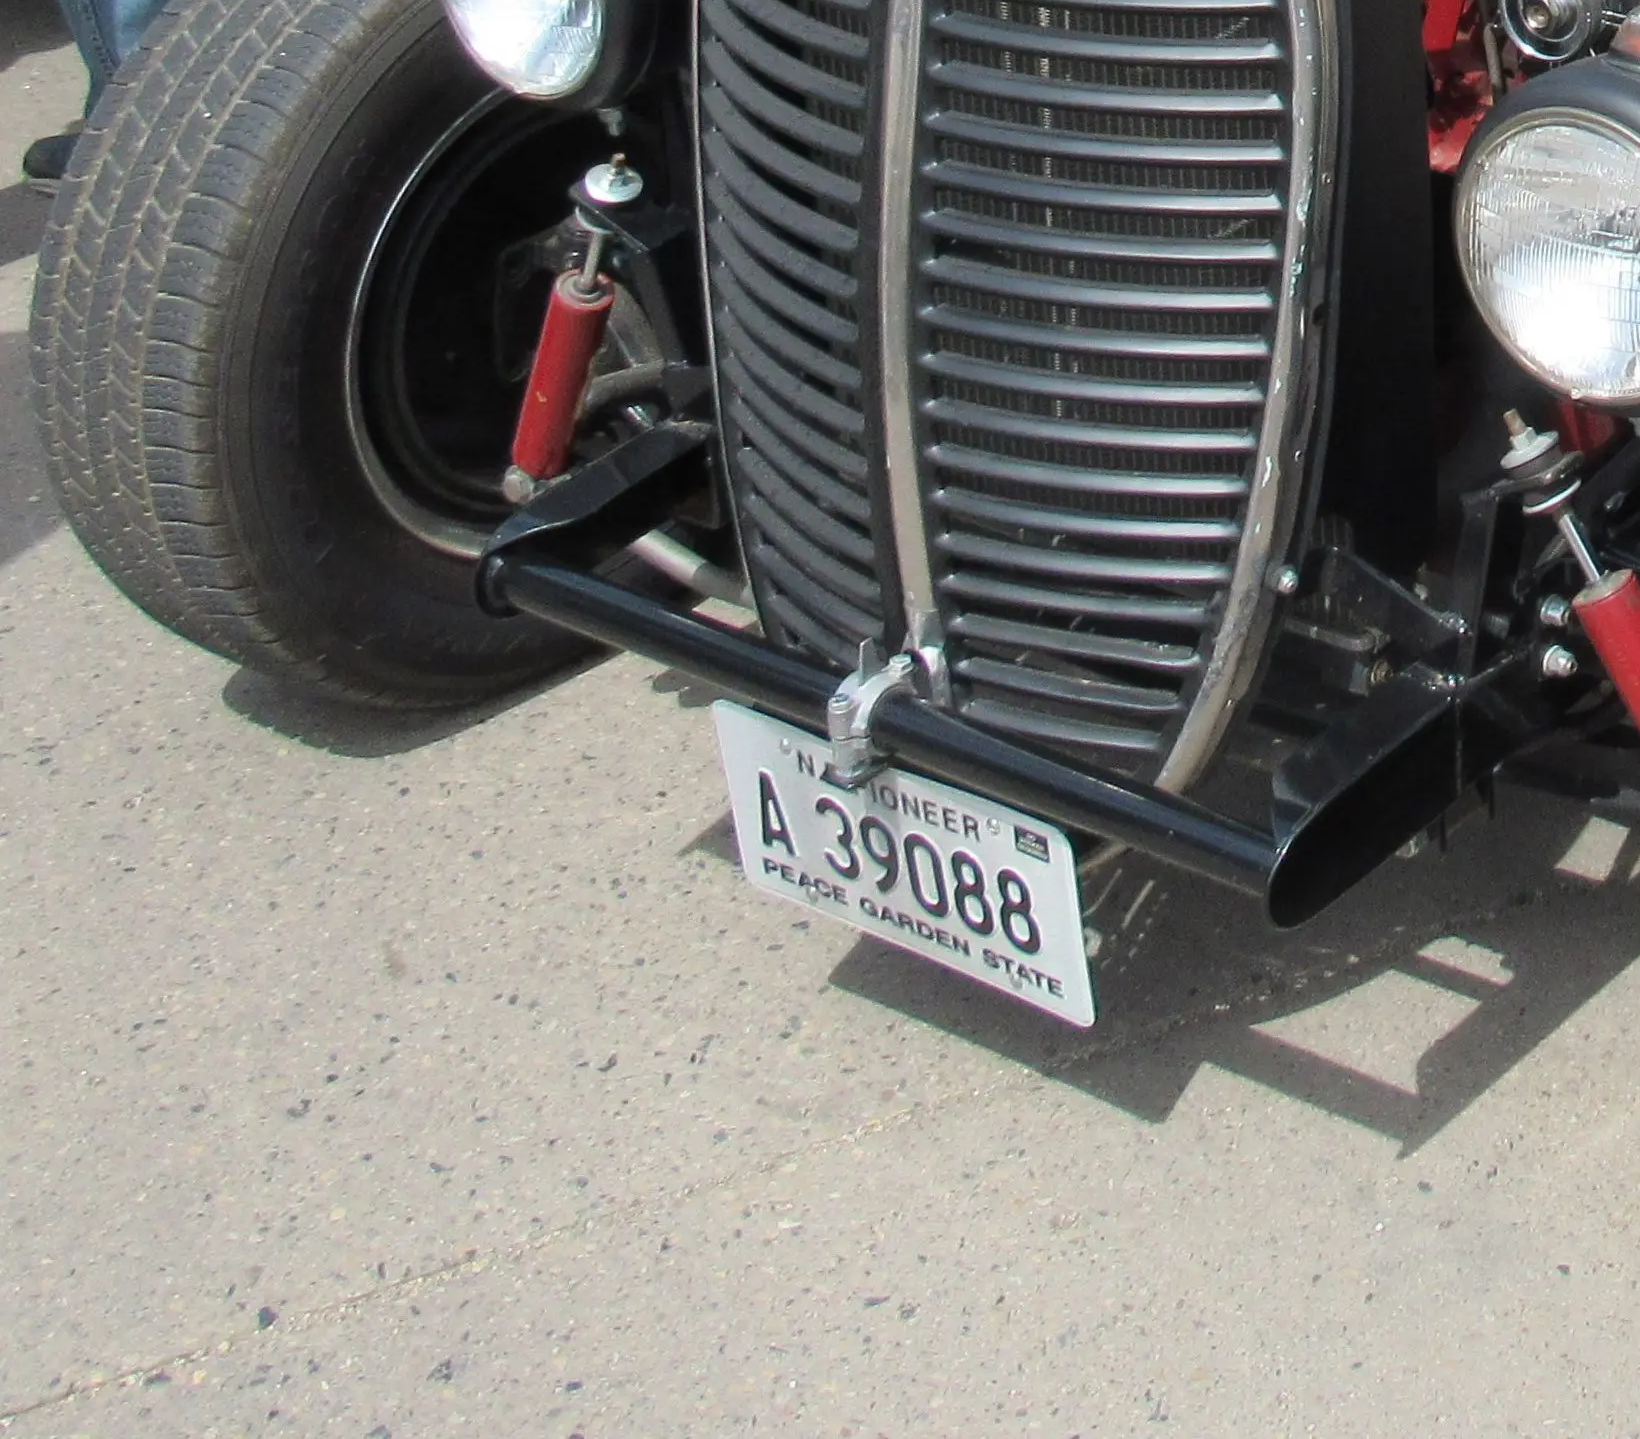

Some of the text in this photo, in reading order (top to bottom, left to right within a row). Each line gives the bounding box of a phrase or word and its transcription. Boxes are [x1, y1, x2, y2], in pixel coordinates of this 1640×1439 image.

[758, 770, 1042, 955] A 39088
[867, 779, 981, 844] IONEER
[761, 856, 1066, 1000] PEACE GARDEN STATE
